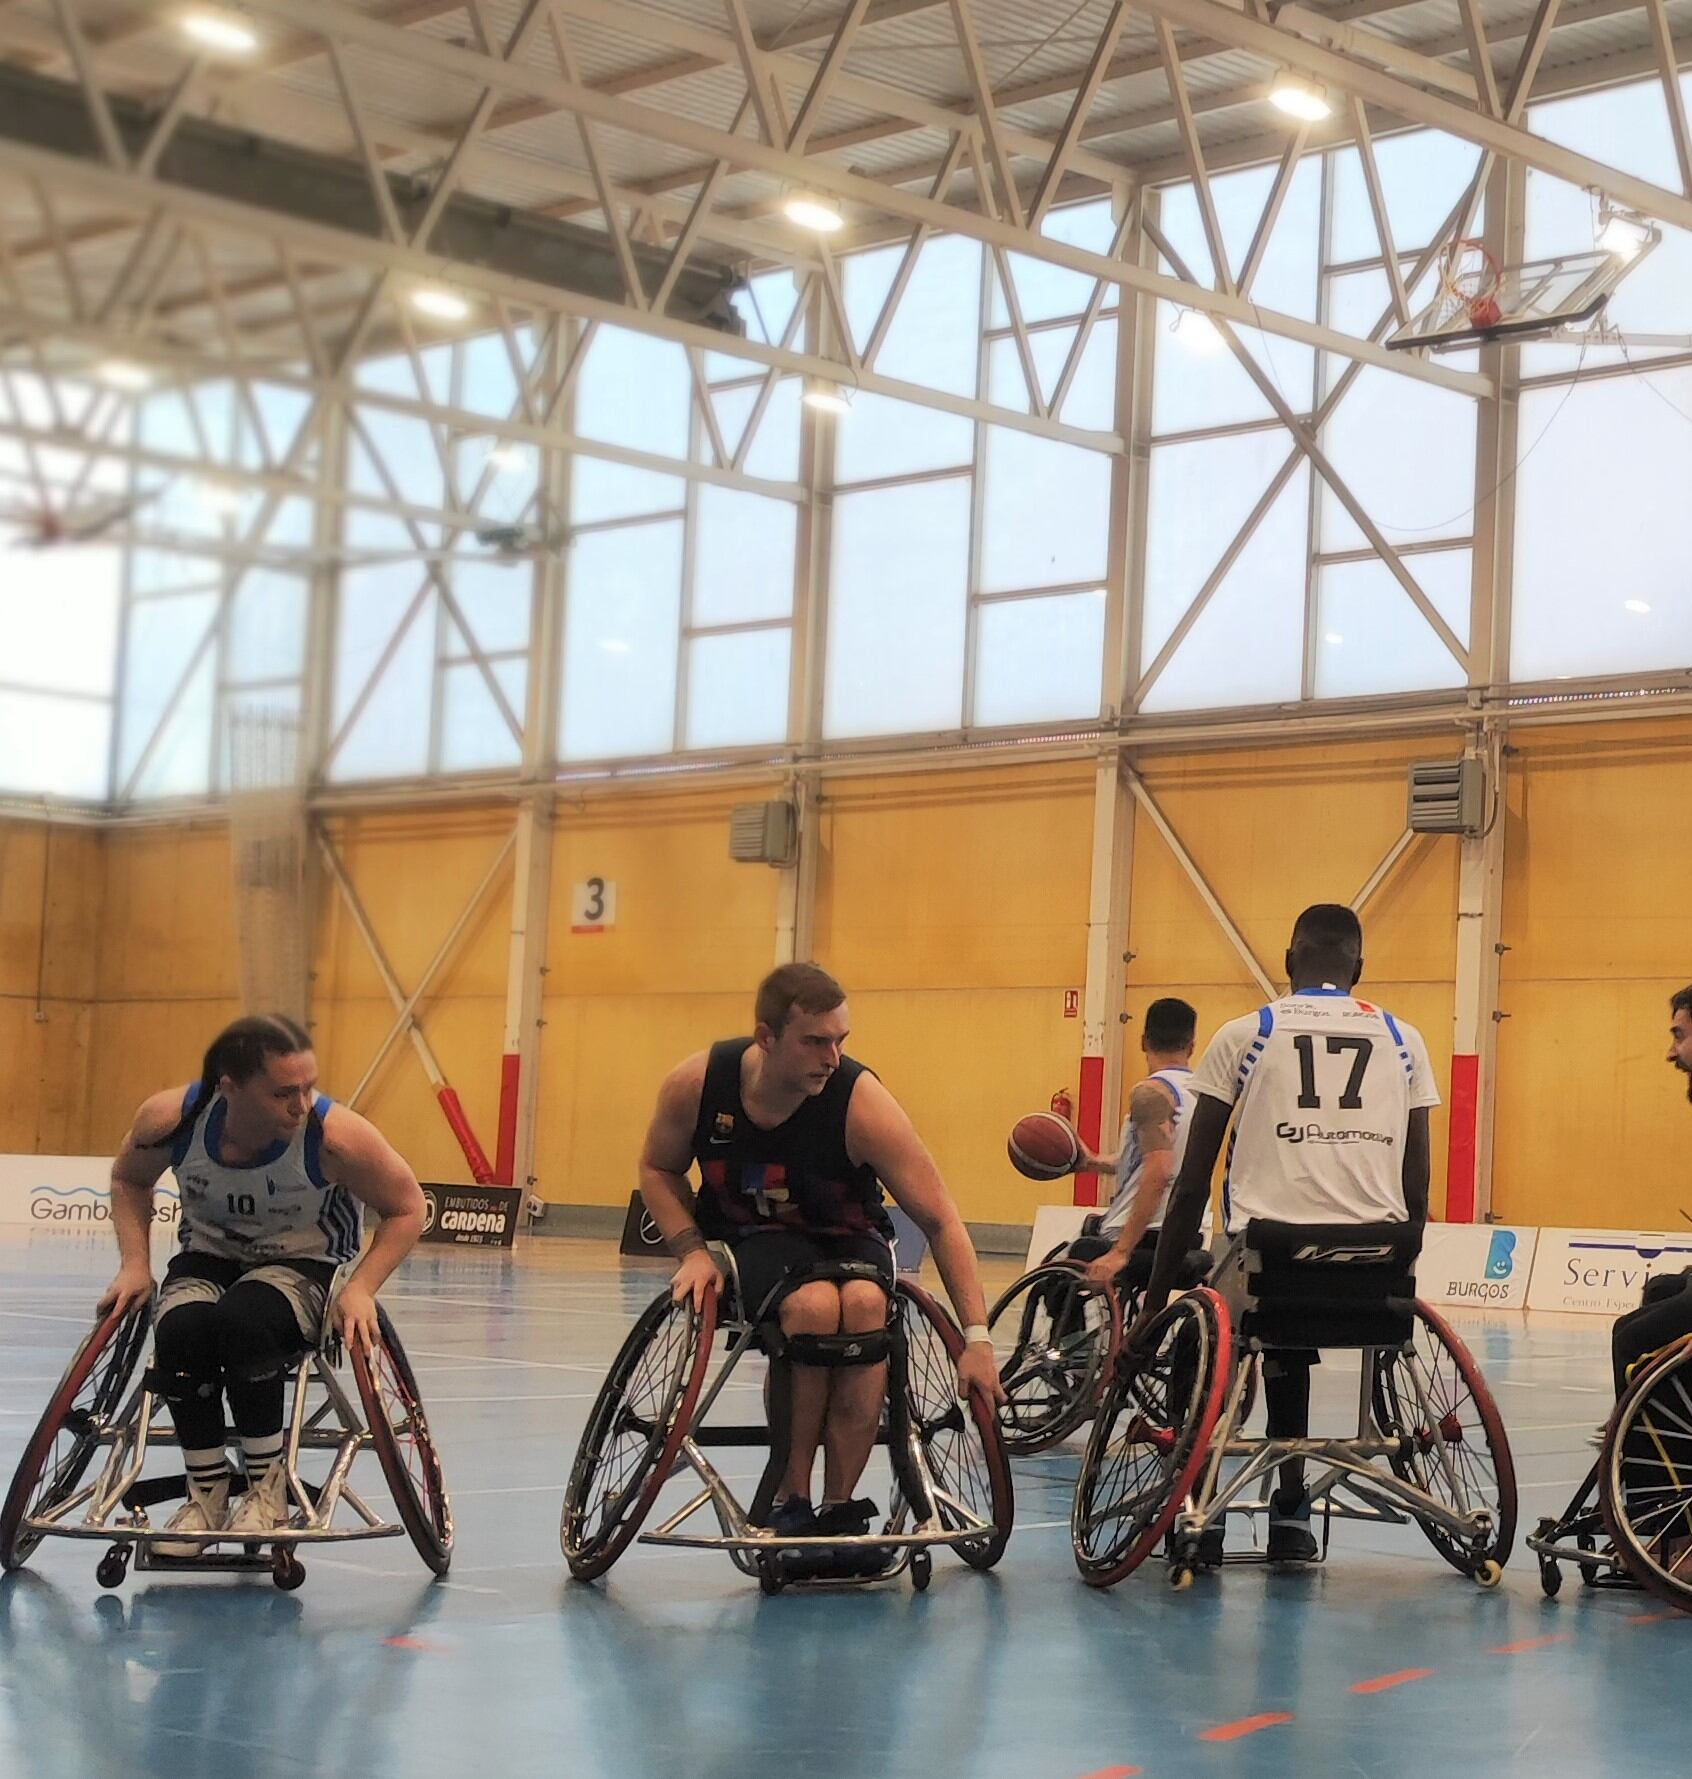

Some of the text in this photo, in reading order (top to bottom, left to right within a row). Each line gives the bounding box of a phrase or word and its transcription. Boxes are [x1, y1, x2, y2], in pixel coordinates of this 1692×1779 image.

[584, 877, 605, 921] 3
[1292, 1034, 1375, 1110] 17
[30, 1197, 184, 1224] Gambsh
[226, 1192, 256, 1216] 10
[1445, 1281, 1510, 1305] BURGOS
